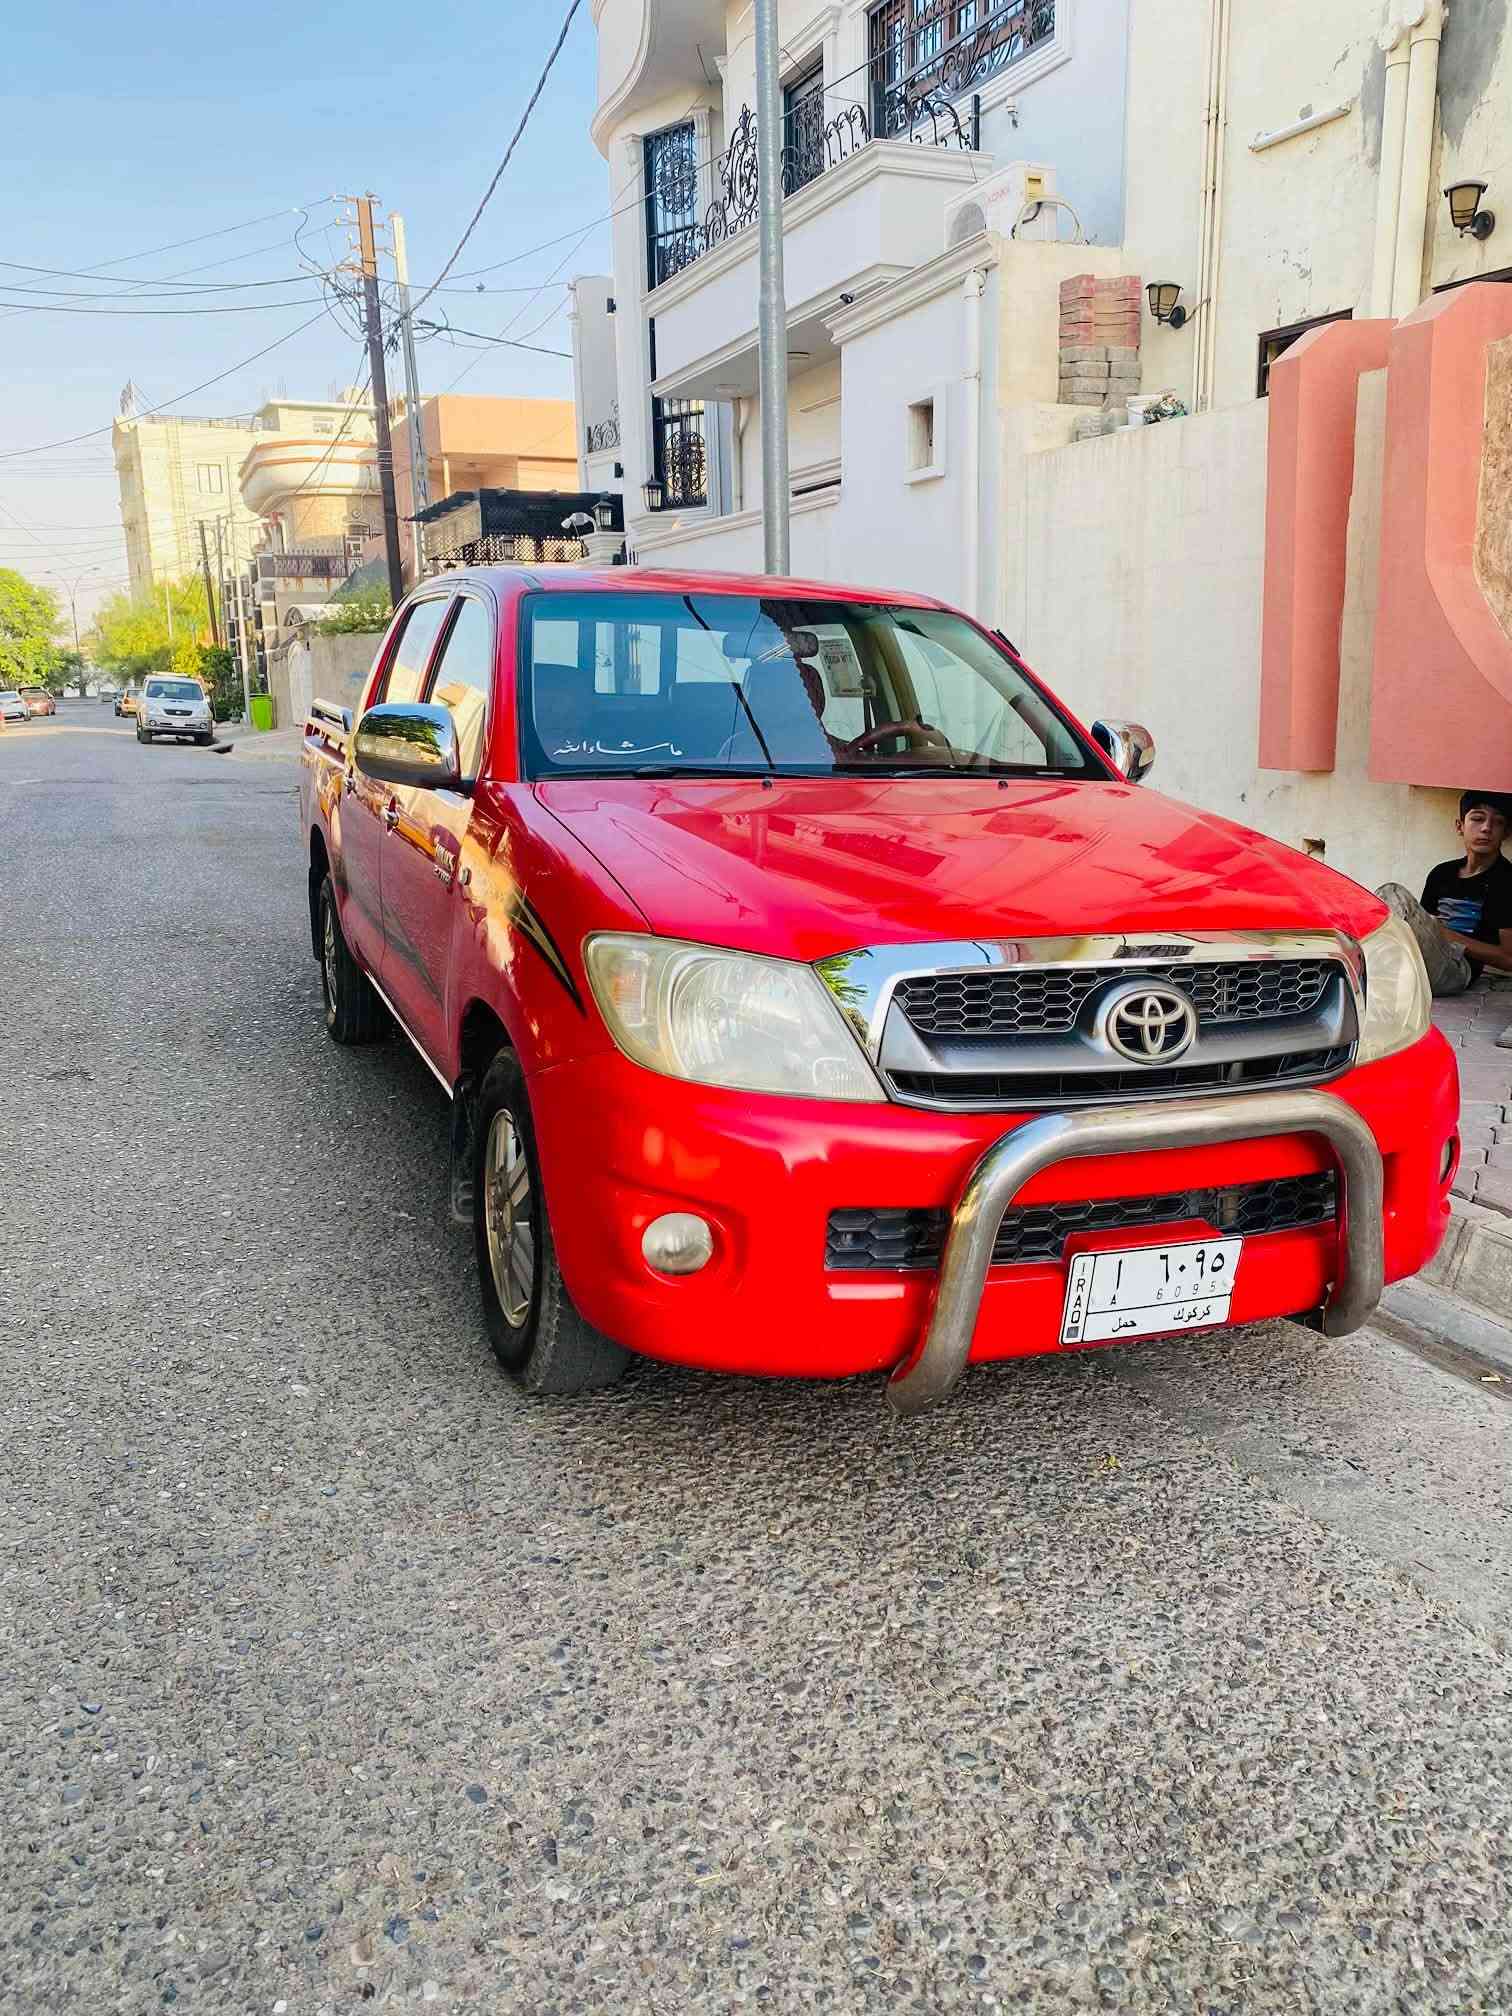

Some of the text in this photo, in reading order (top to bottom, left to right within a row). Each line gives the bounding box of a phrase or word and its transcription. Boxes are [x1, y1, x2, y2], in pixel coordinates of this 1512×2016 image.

[1159, 1248, 1226, 1284] ٦٠٩٥
[1070, 1262, 1087, 1324] IRAQ
[1156, 1280, 1217, 1301] 6095
[1173, 1304, 1213, 1323] كركوك
